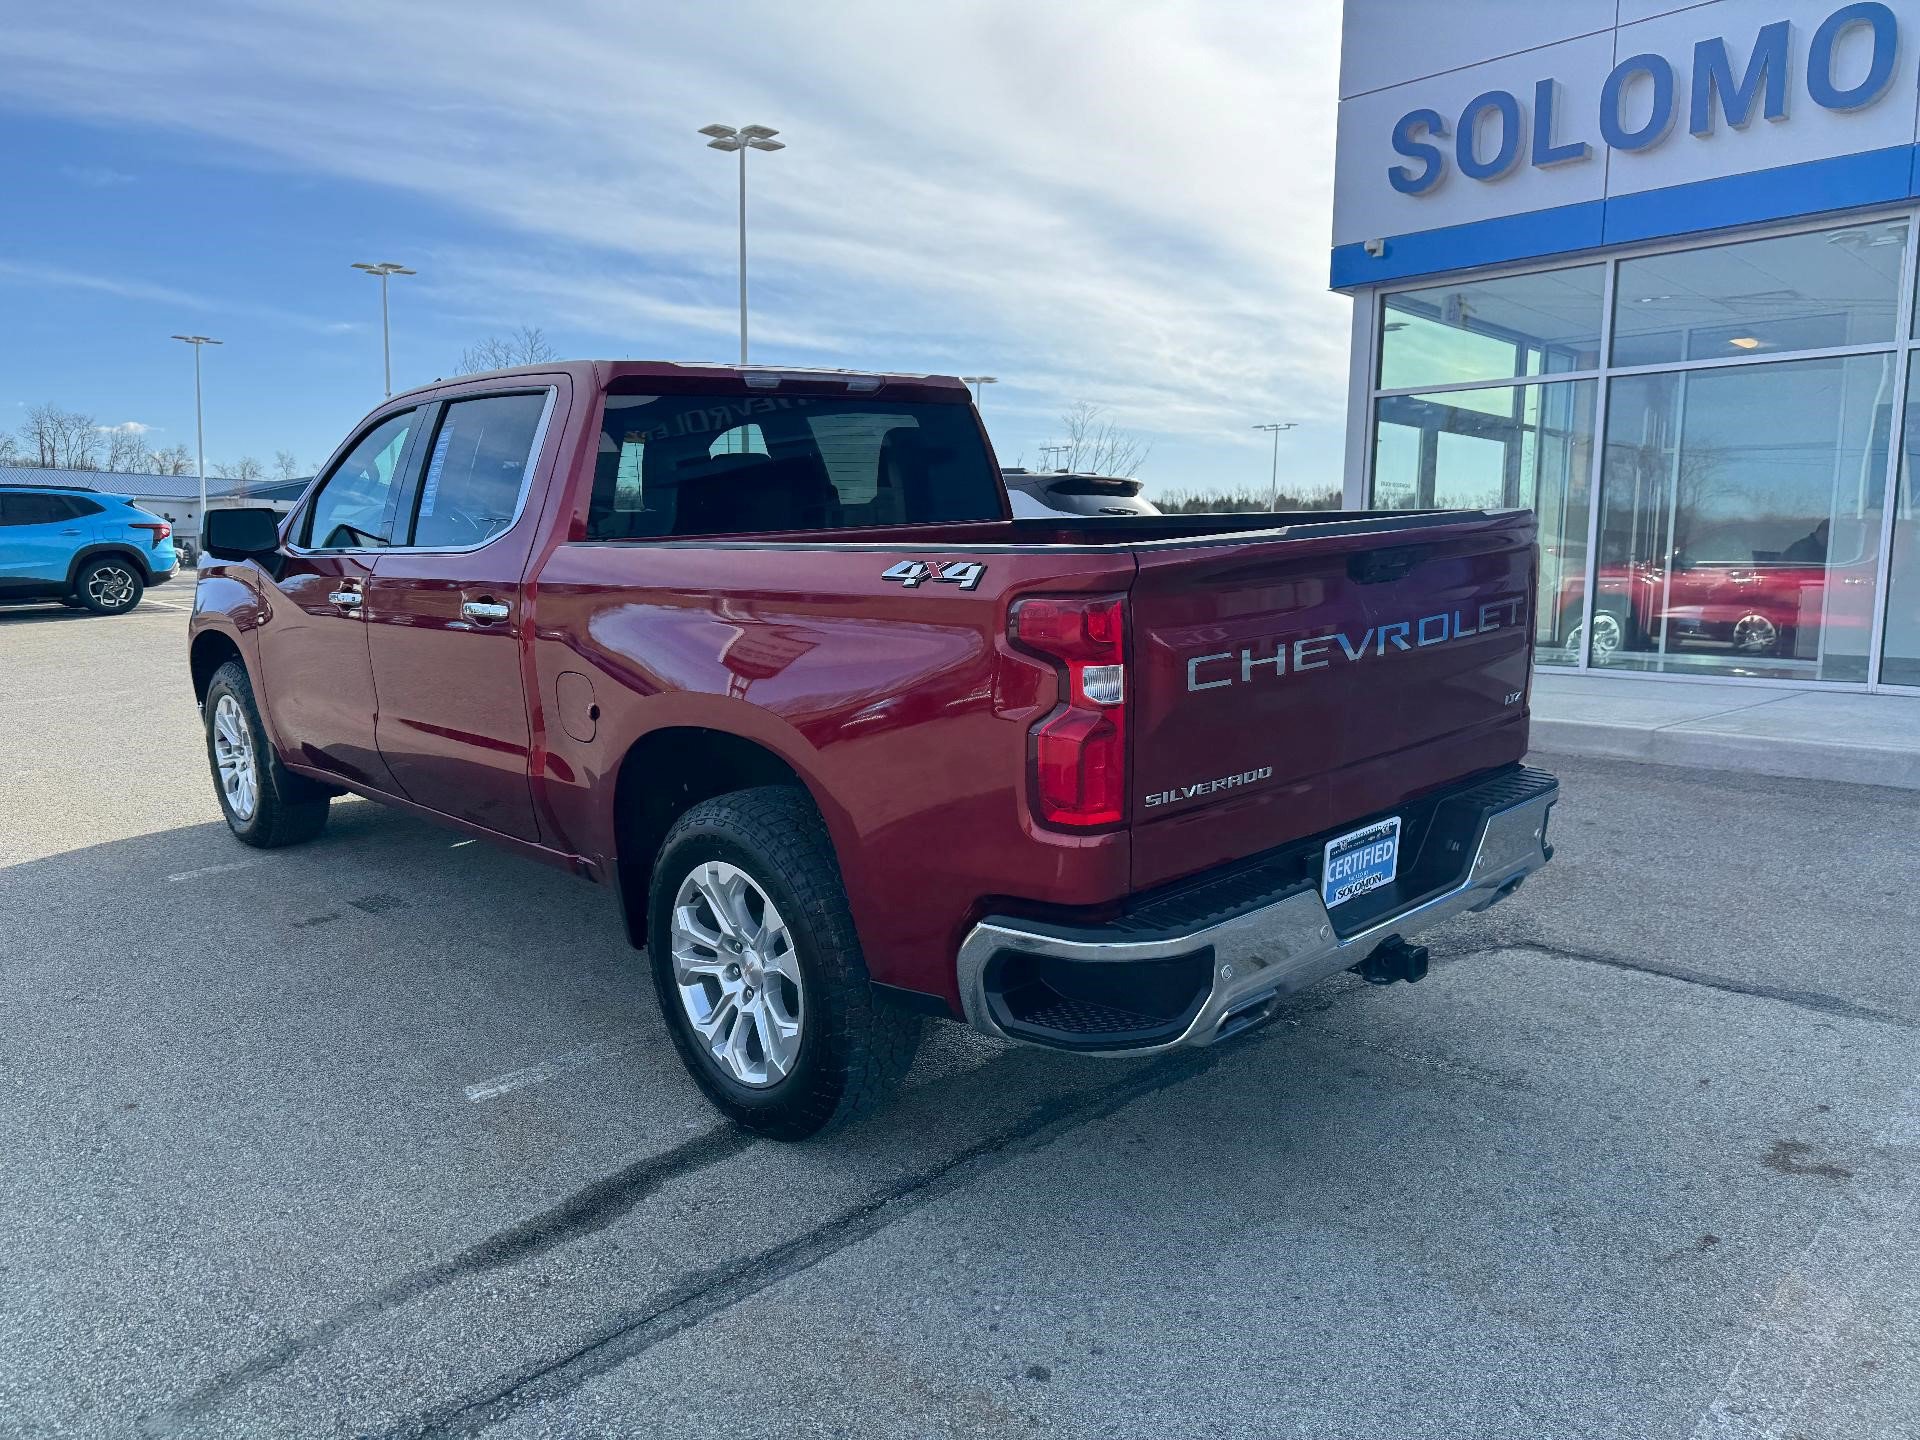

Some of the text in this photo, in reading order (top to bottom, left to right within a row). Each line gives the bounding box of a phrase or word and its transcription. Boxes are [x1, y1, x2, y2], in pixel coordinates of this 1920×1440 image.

[1388, 1, 1920, 197] SOLOMO
[1187, 597, 1523, 692] CHEVROLET
[1504, 691, 1522, 706] LTZ
[1145, 766, 1273, 808] SILVERADO
[1327, 840, 1394, 883] CERTIFIED
[1337, 873, 1384, 900] SOLOMON
